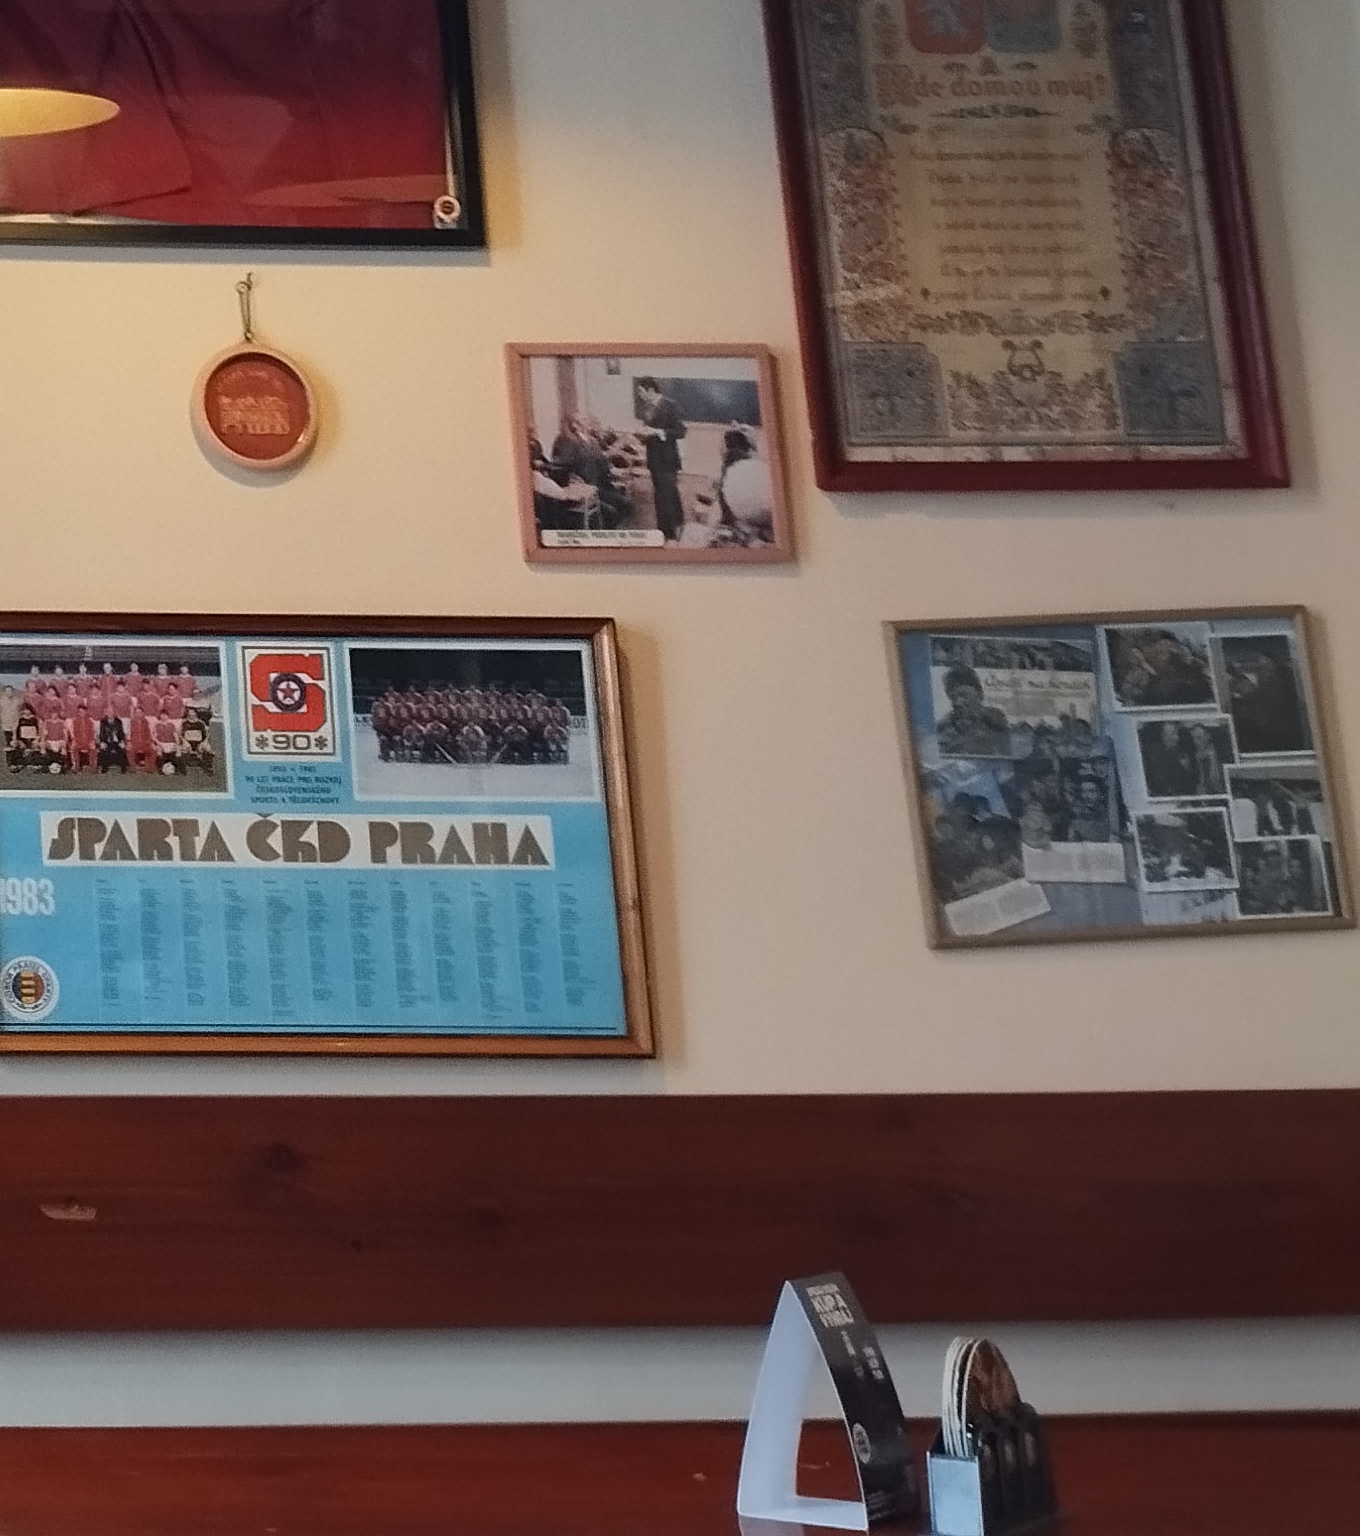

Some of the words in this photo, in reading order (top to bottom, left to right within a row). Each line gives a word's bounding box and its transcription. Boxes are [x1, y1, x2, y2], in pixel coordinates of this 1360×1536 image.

[48, 816, 236, 863] SPARTA
[245, 812, 352, 864] ČKD
[368, 820, 551, 866] PRAHA
